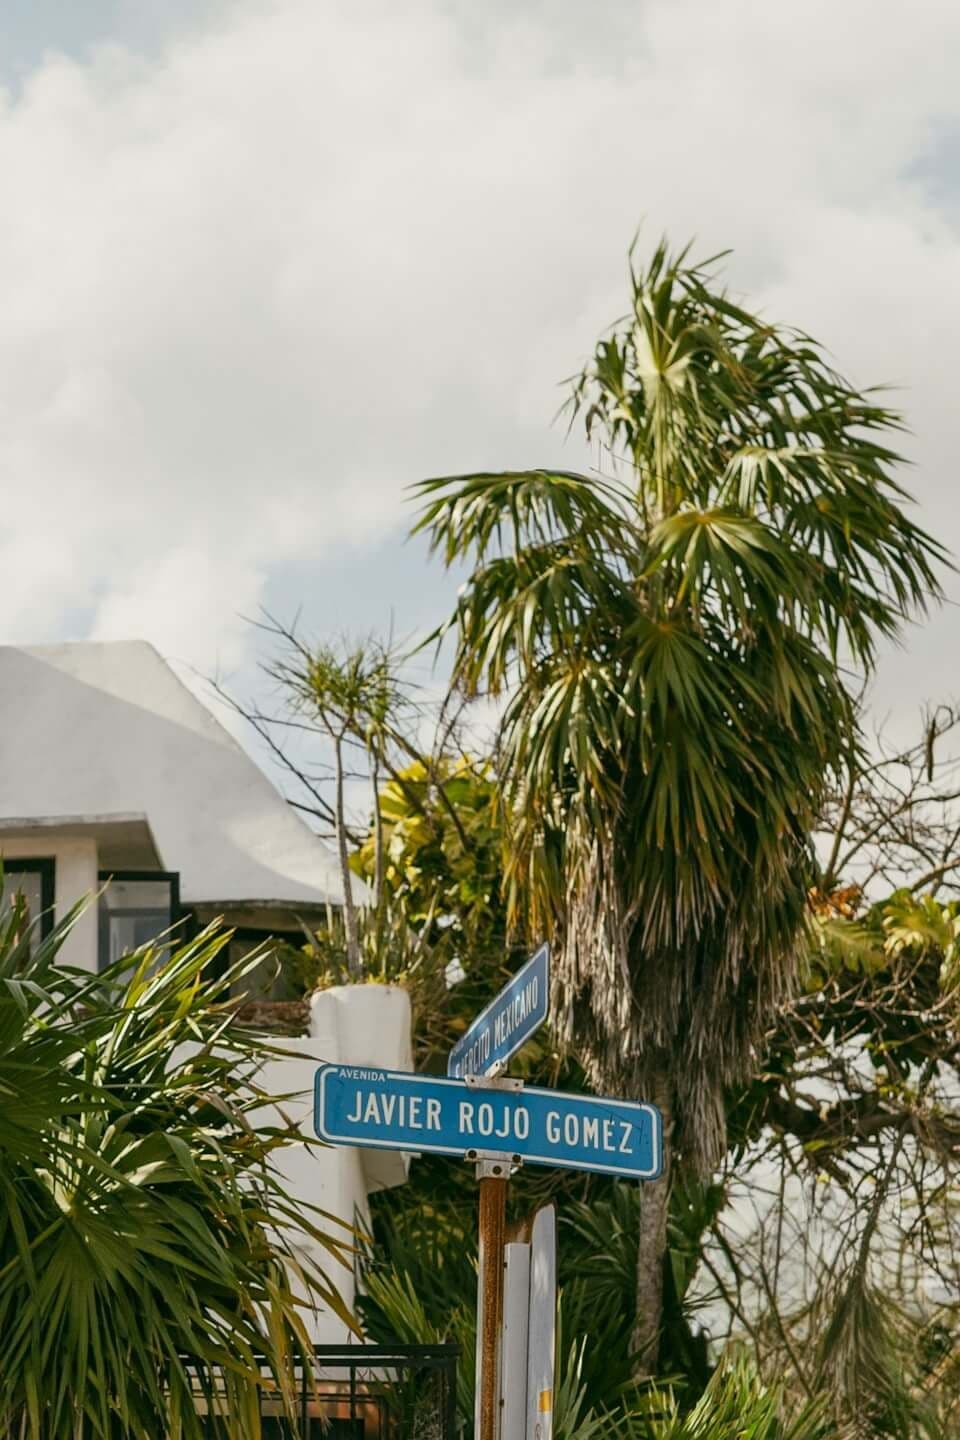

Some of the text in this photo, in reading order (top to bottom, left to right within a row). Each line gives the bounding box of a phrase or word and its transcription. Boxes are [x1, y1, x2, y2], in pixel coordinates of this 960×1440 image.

[494, 975, 538, 1050] MEXICANO
[340, 1068, 386, 1082] AVENIDA
[346, 1091, 633, 1154] JAVIER ROJO GOMEZ
